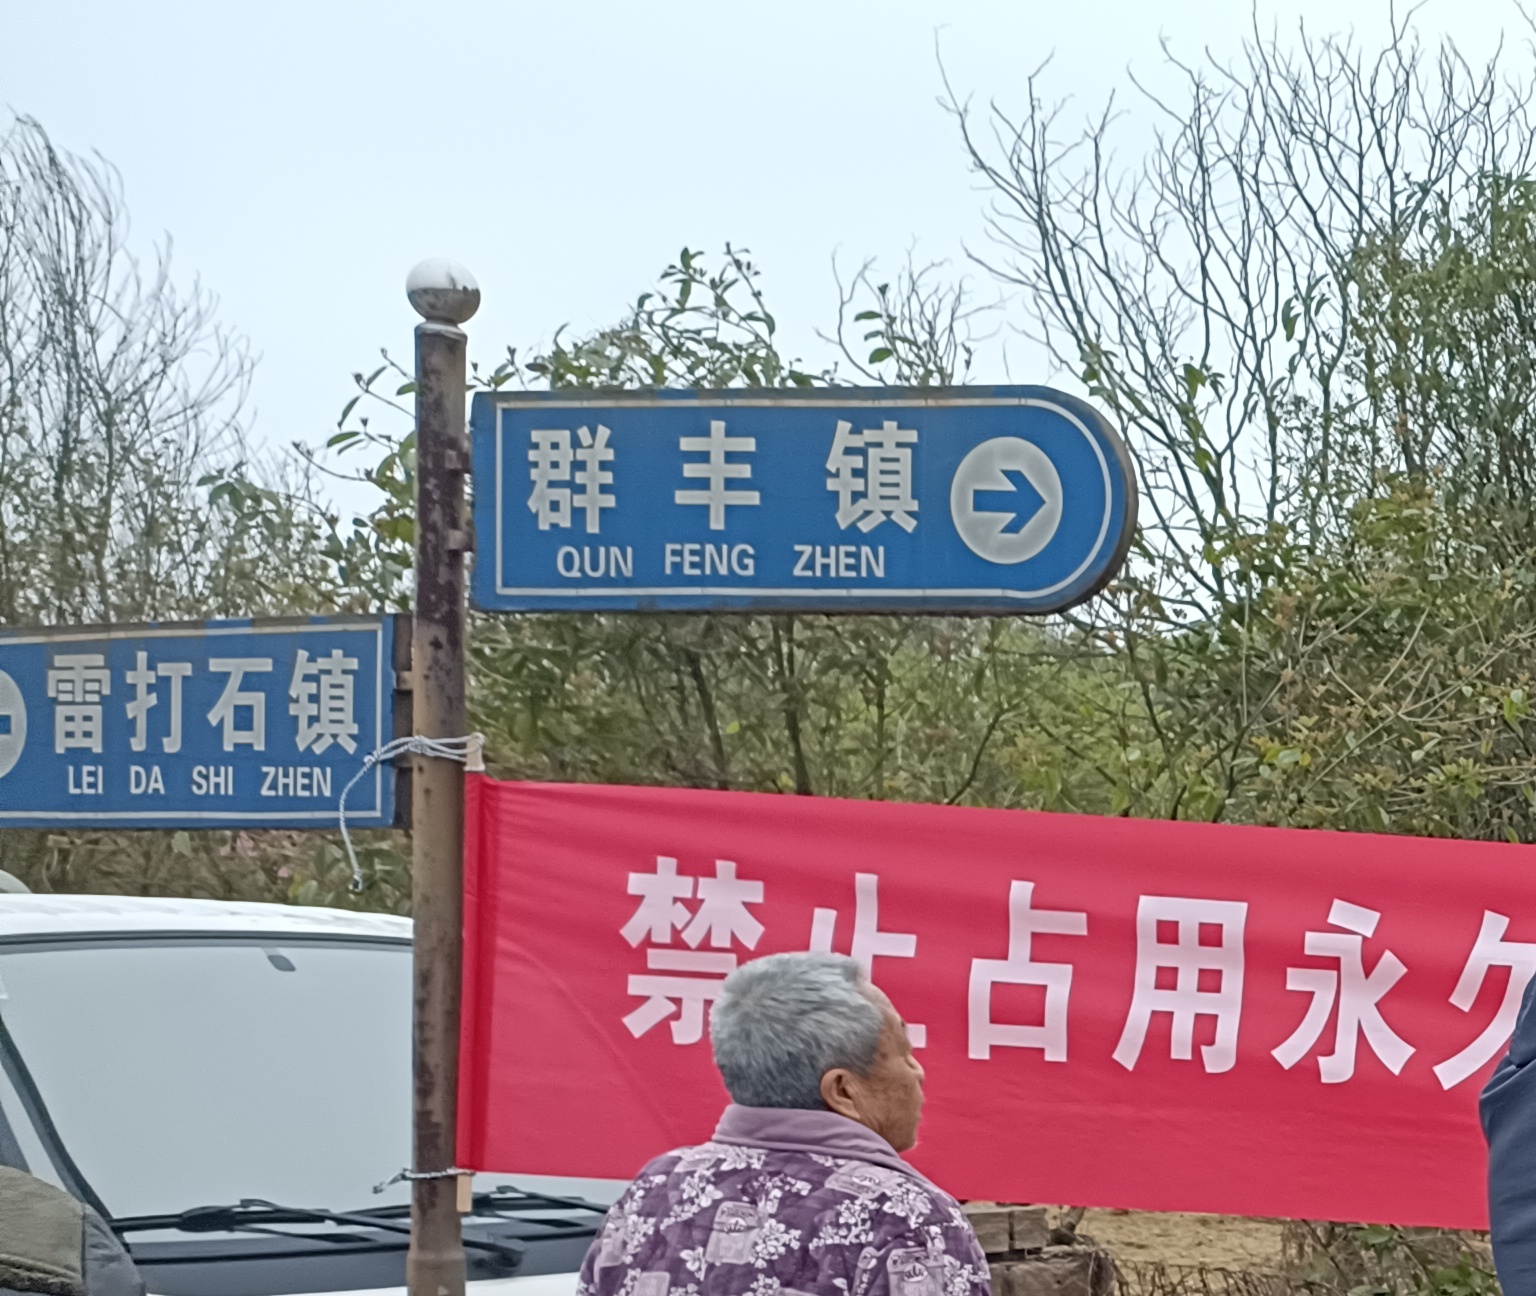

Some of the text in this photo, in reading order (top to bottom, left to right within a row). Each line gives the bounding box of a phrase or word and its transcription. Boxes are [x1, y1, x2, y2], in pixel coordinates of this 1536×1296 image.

[528, 420, 918, 533] 群丰镇
[556, 543, 885, 579] QUN FENG ZHEN
[47, 650, 359, 756] 雷打石镇
[68, 765, 332, 797] LEI DA SHI ZHEN
